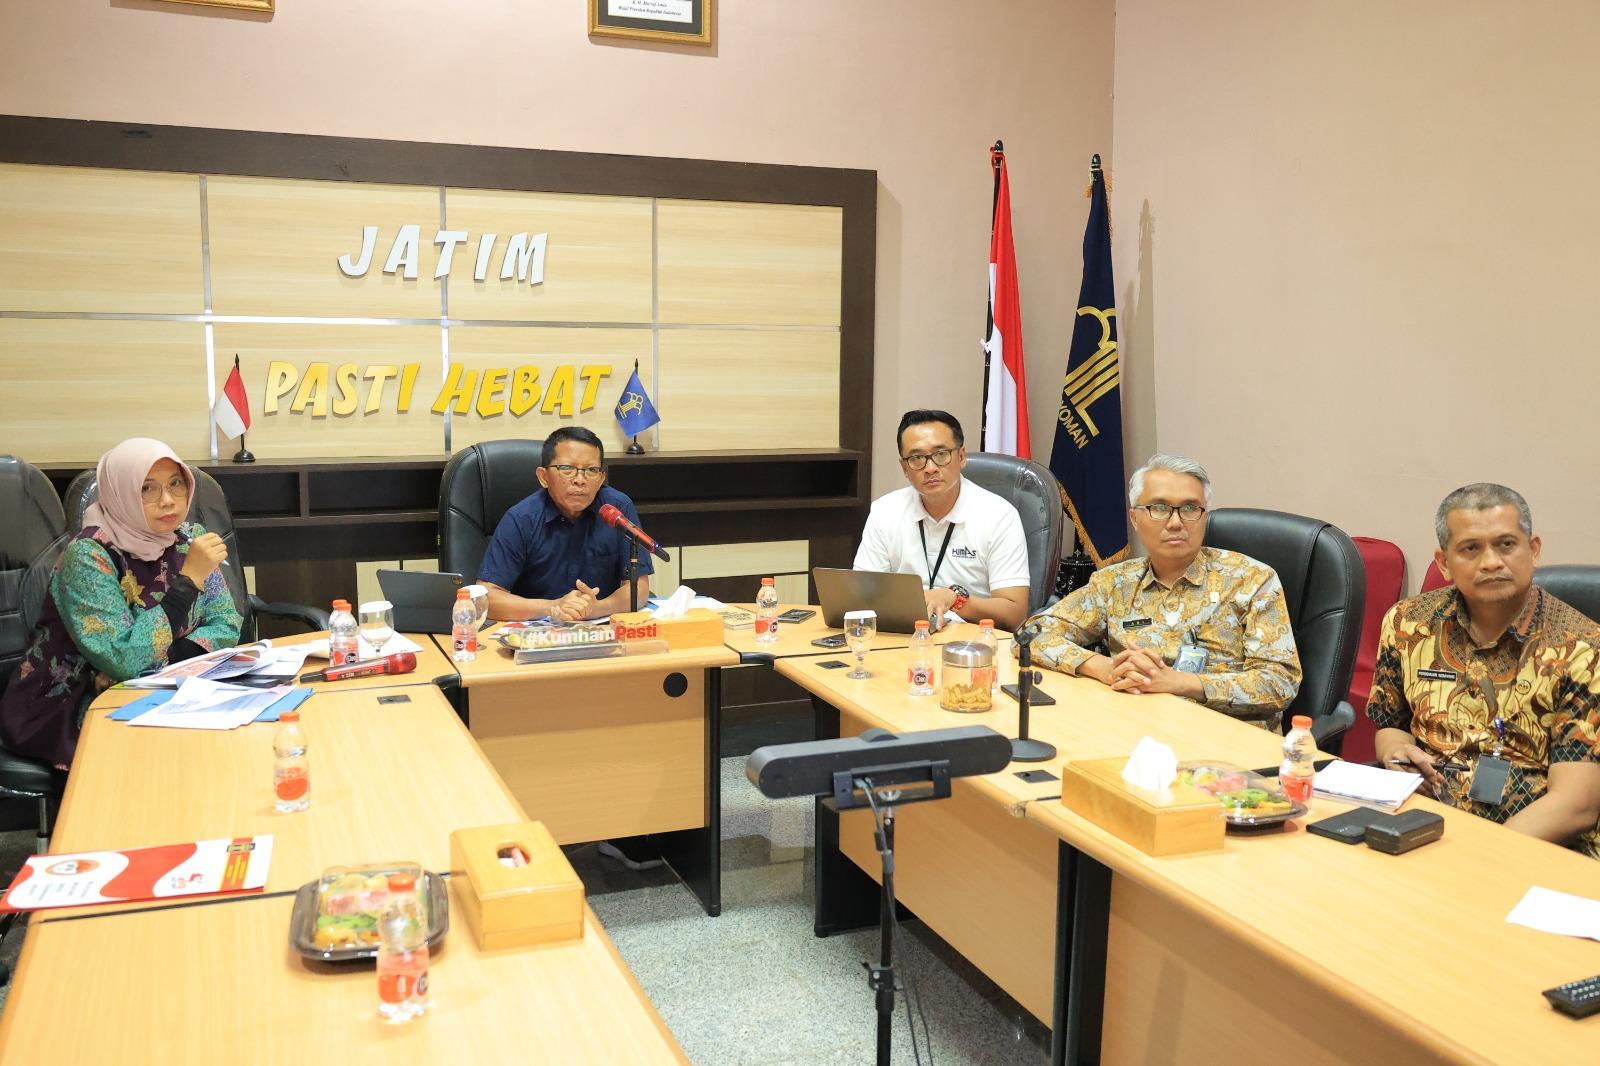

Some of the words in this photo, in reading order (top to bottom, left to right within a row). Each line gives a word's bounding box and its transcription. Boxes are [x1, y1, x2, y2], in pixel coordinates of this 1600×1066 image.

[338, 224, 549, 286] JATIM
[263, 360, 420, 418] PASTI
[430, 361, 613, 418] HEBAT
